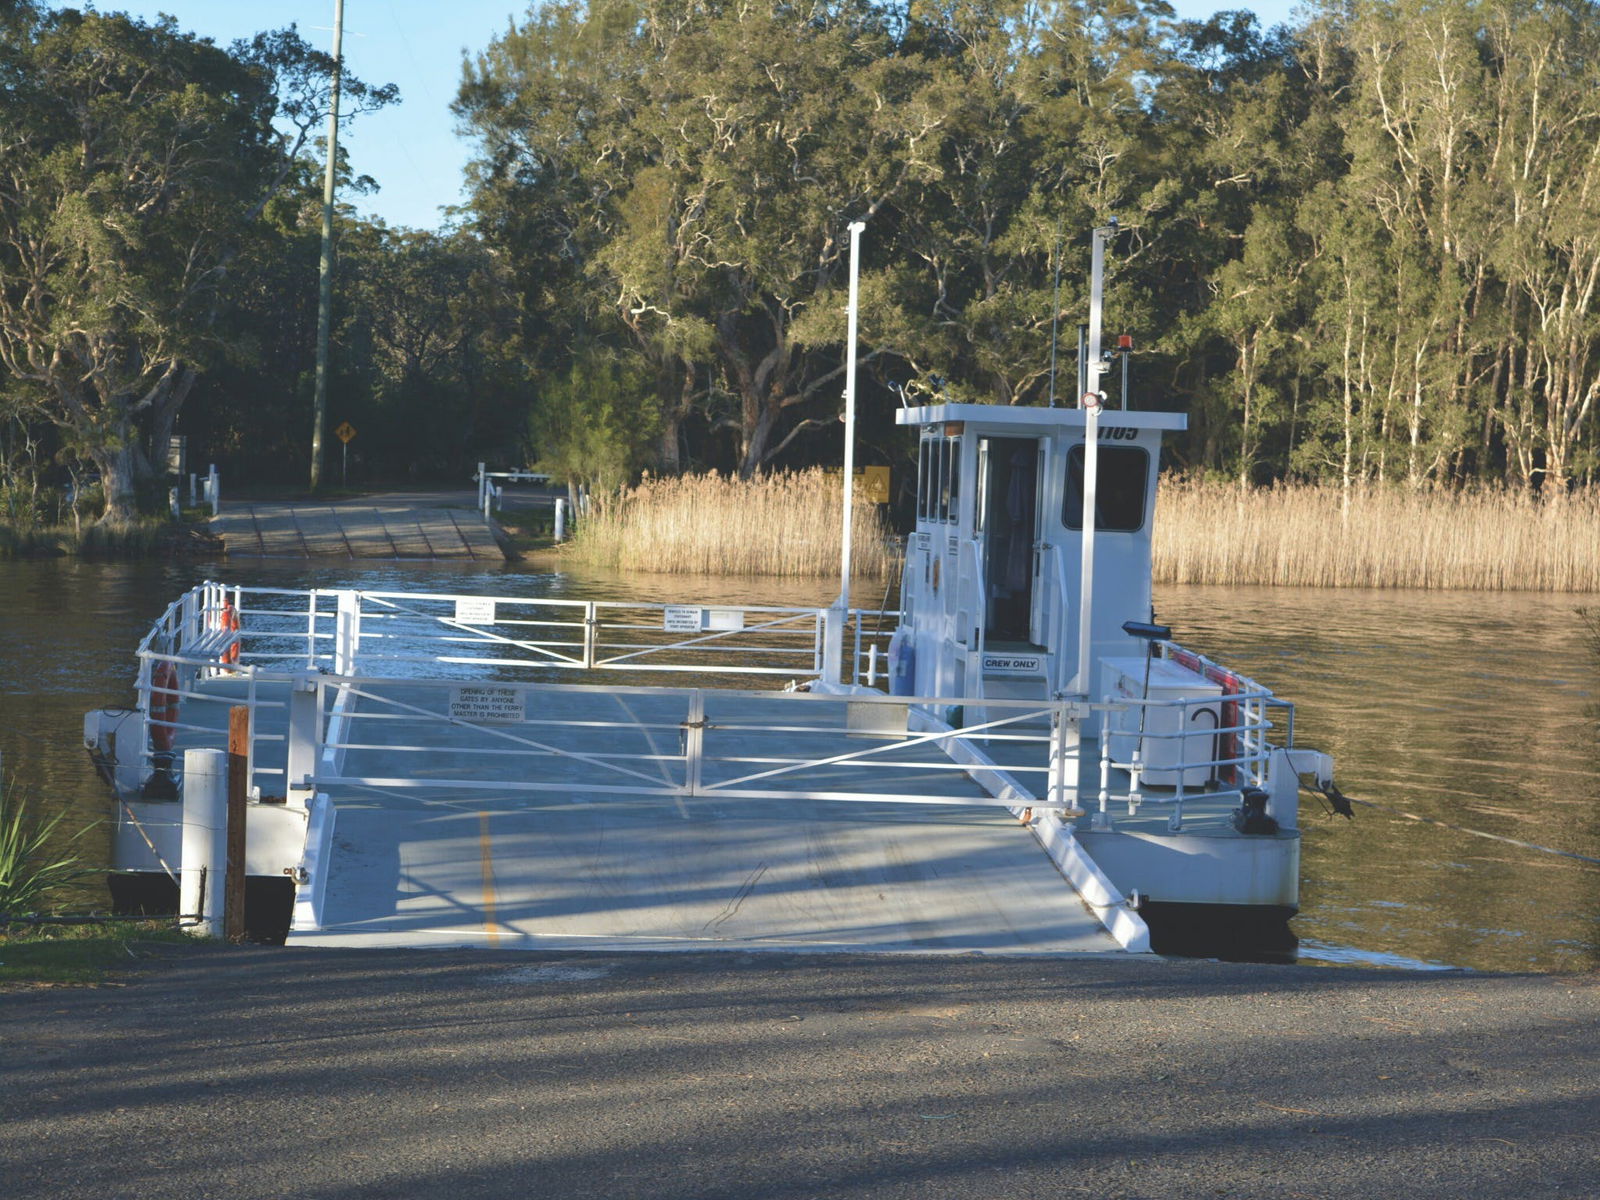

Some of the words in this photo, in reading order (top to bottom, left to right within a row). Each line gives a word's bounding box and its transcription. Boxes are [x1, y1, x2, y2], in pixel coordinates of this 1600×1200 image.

[985, 659, 1011, 668] CREW
[1013, 660, 1037, 669] ONLY
[460, 695, 479, 703] GATES
[487, 711, 520, 719] PROHIBITED
